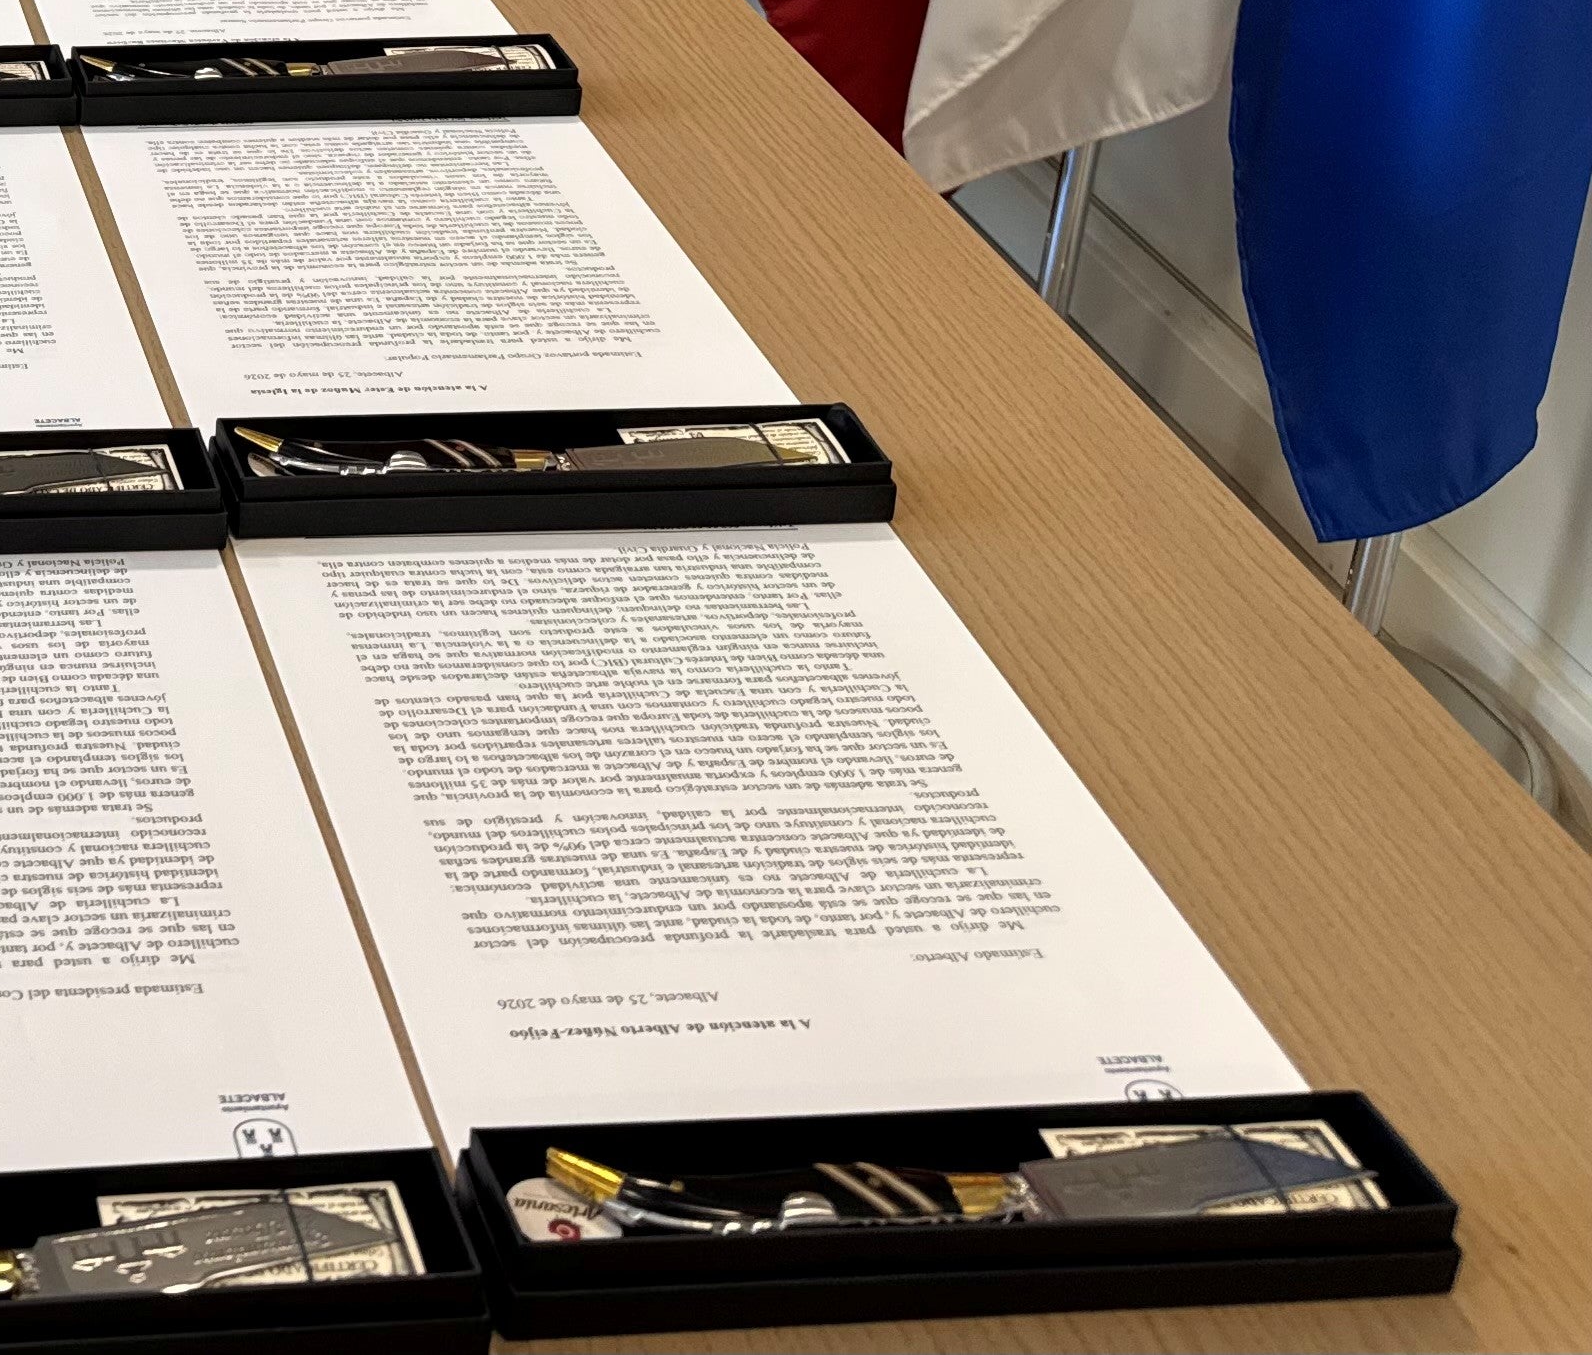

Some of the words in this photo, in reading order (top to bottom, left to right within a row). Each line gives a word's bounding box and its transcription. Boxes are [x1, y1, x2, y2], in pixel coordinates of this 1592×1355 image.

[649, 544, 698, 554] Guardia
[712, 542, 765, 552] Nacional
[766, 542, 810, 551] Policía
[120, 953, 161, 967] dirijo
[169, 953, 196, 965] Me
[973, 947, 1046, 961] Estimado
[11, 956, 44, 968] para
[53, 957, 93, 970] usted
[101, 956, 111, 965] a
[27, 988, 51, 1001] del
[54, 983, 131, 999] presidenta
[133, 983, 204, 997] Estimada
[538, 997, 557, 1009] de
[560, 993, 603, 1005] mayo
[605, 994, 624, 1006] de
[628, 993, 649, 1006] 25
[649, 991, 719, 1003] Albacete,
[496, 998, 536, 1010] 2026
[620, 1023, 680, 1035] Alberto
[685, 1022, 705, 1034] de
[708, 1020, 776, 1033] atención
[779, 1019, 797, 1030] la
[798, 1018, 811, 1029] A
[509, 1026, 619, 1040] Núñez-Feijóo
[1096, 1054, 1163, 1066] ALBACETE
[218, 1092, 285, 1104] ALBACETE
